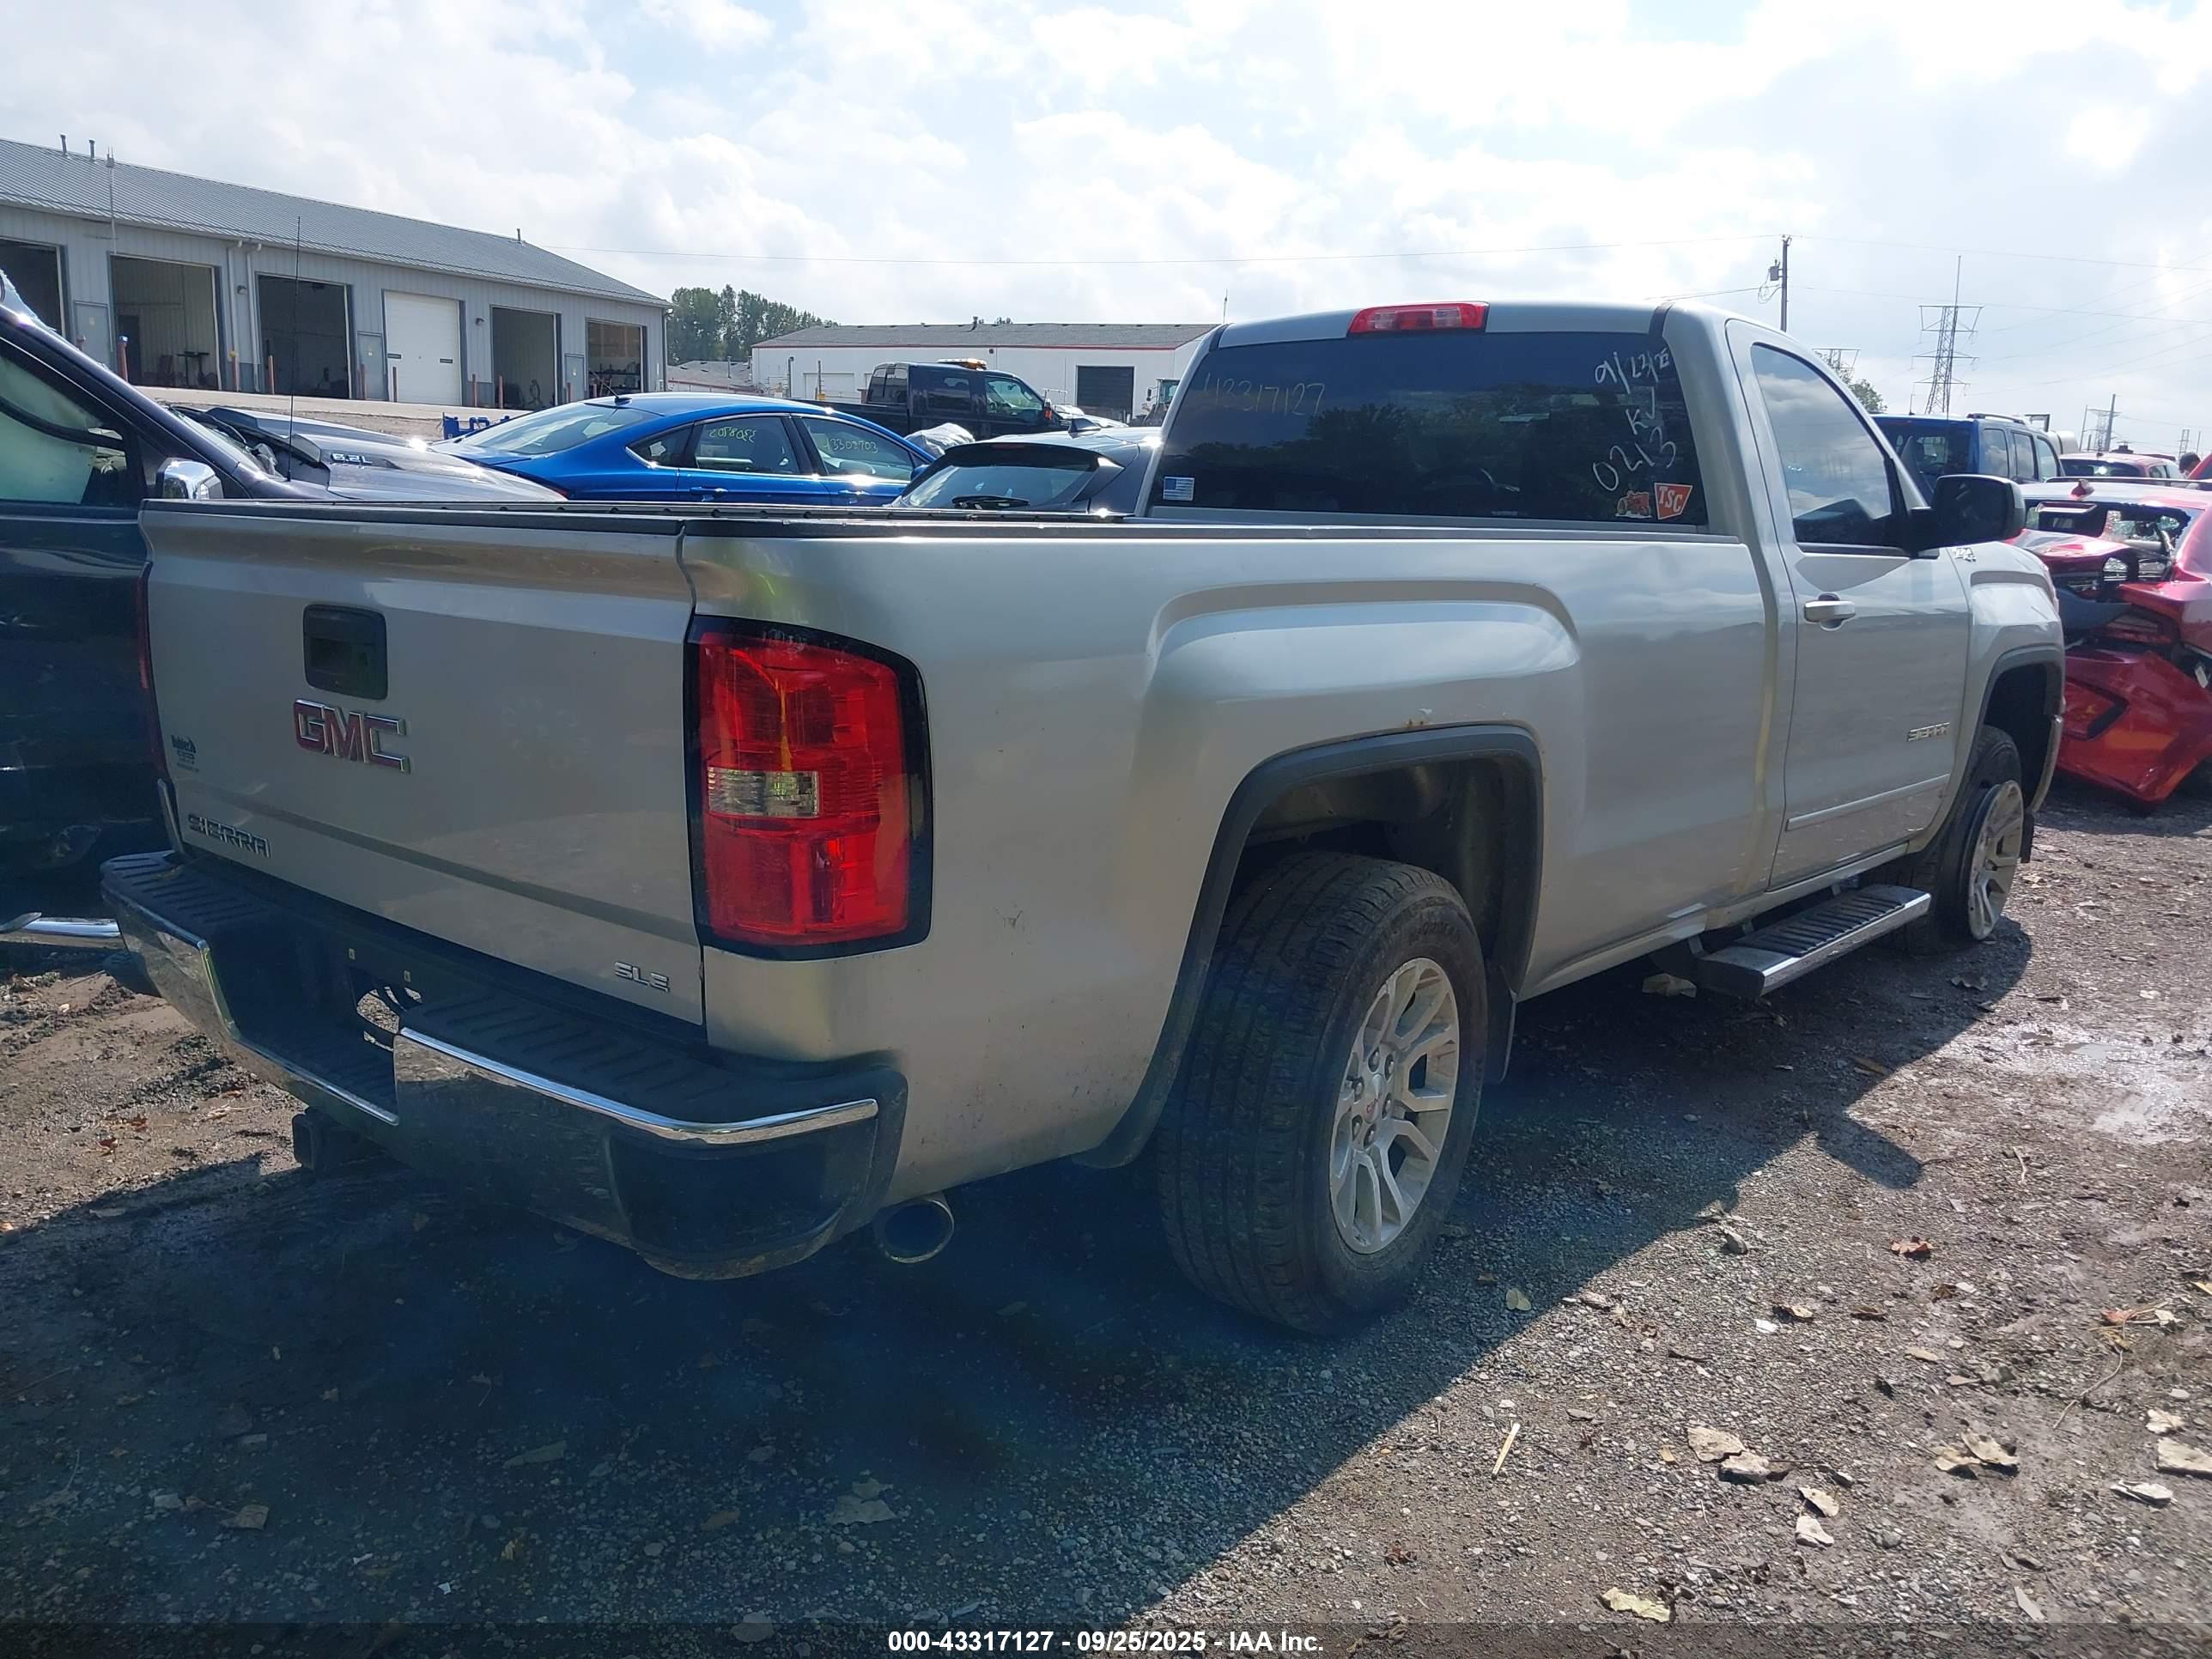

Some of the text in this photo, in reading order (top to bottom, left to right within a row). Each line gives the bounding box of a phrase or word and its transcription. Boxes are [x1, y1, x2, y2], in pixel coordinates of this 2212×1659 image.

[1592, 426, 1677, 491] 0213
[1658, 485, 1684, 514] TSC
[294, 698, 411, 775] GMC
[188, 813, 272, 860] SIERRA
[613, 960, 671, 993] SLE
